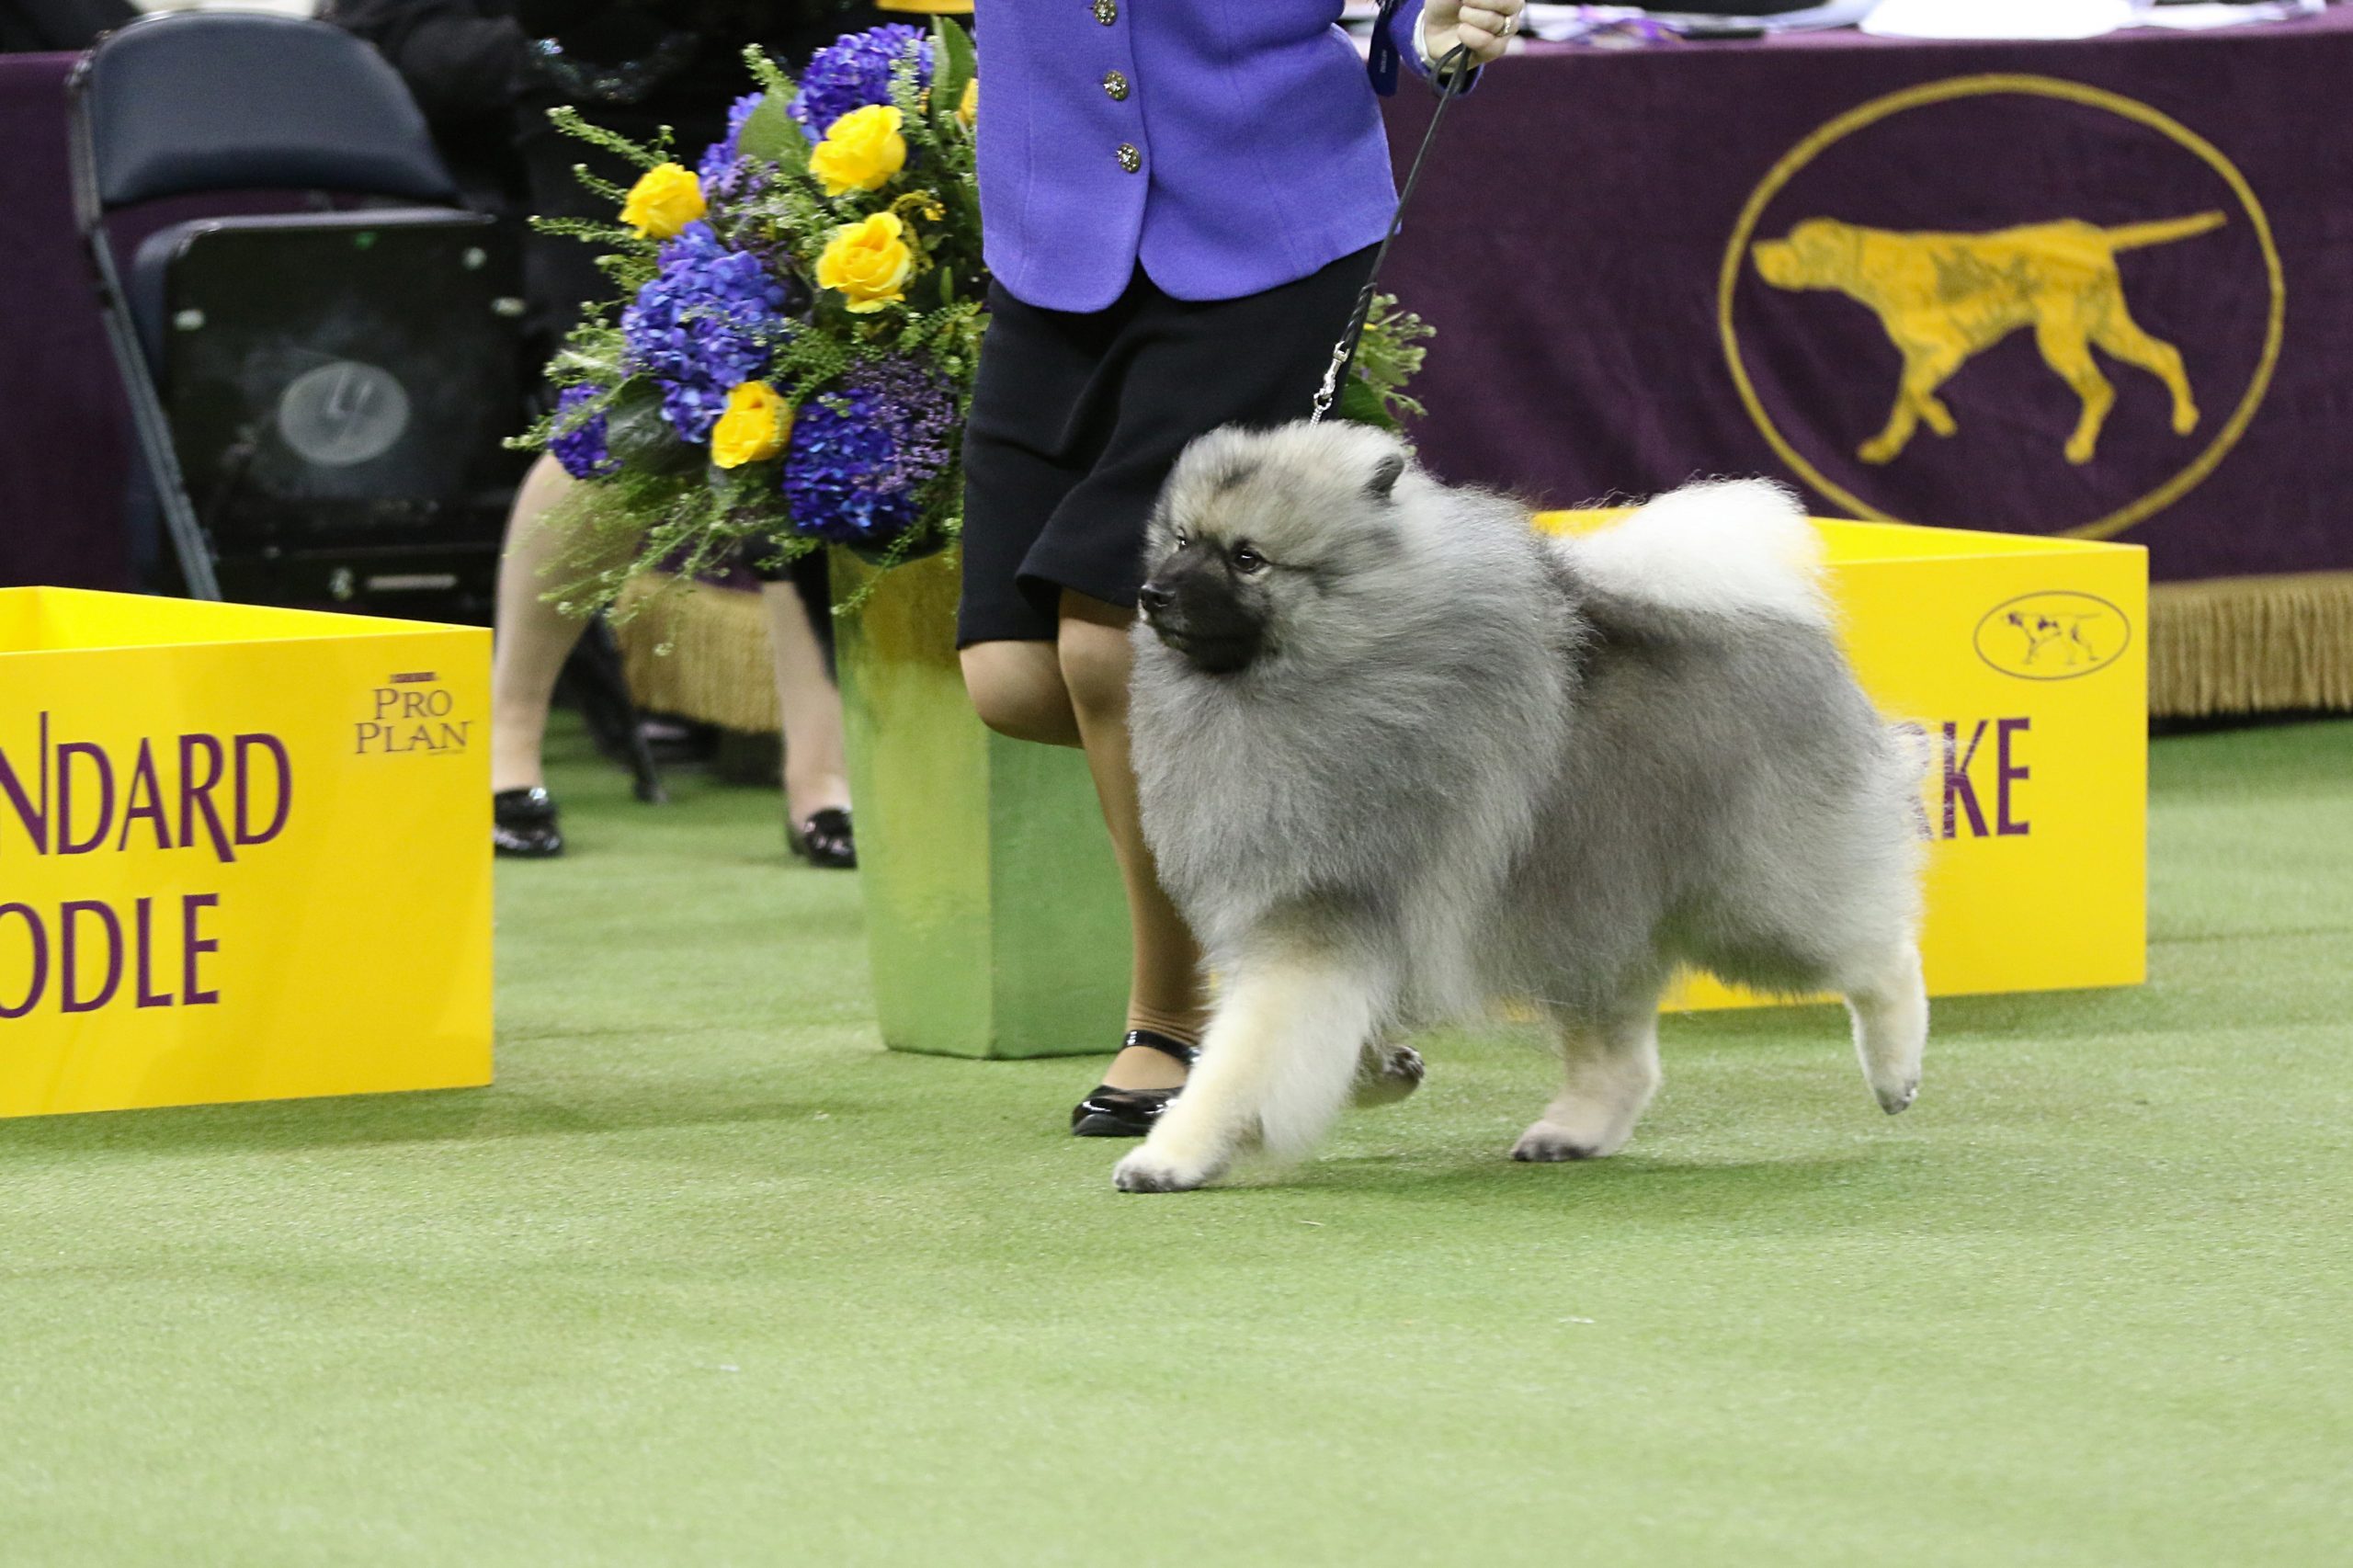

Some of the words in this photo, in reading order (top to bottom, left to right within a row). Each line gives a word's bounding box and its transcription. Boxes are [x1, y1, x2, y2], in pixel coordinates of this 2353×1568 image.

[354, 721, 472, 755] PLAN
[373, 687, 453, 720] PRO
[0, 710, 292, 863] NDARD
[1901, 716, 2030, 841] KE
[0, 892, 220, 1018] ODLE
